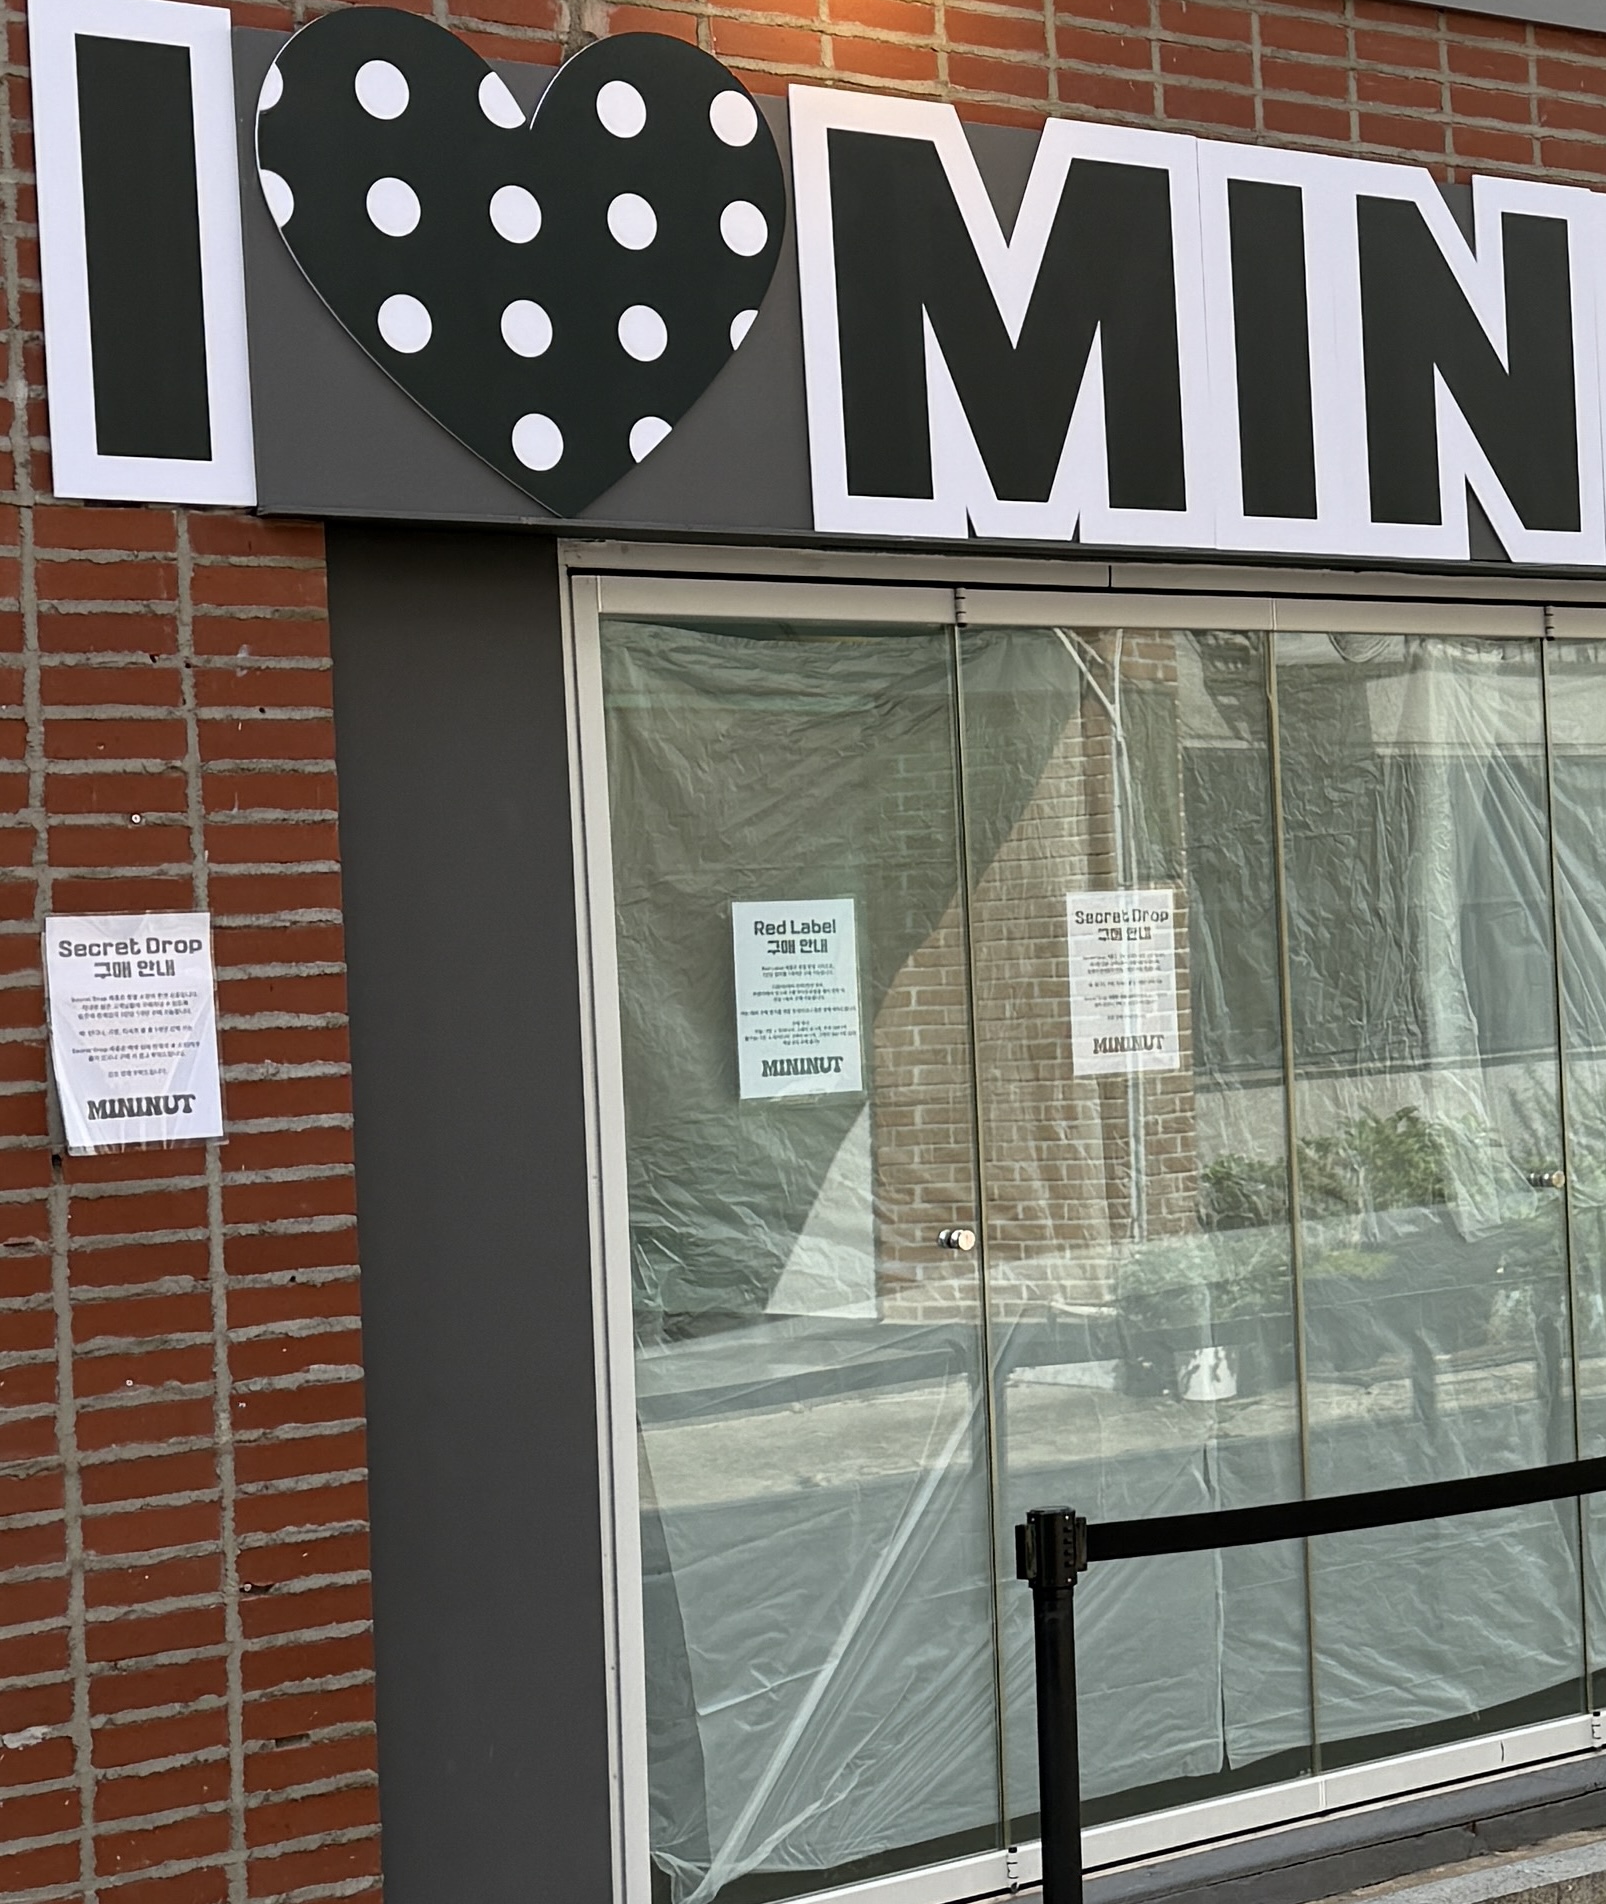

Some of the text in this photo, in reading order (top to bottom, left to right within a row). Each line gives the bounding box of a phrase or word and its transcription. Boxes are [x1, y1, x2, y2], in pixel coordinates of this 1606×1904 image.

[45, 4, 240, 488] I
[753, 918, 836, 936] Red Label
[1074, 908, 1169, 925] Secret Drop
[58, 937, 203, 958] Secret Drop
[767, 938, 828, 955] 구매 안내
[94, 959, 176, 979] 구매 안내
[1092, 1034, 1165, 1055] MININUT
[761, 1055, 844, 1077] MININUT
[86, 1093, 196, 1121] MININUT
